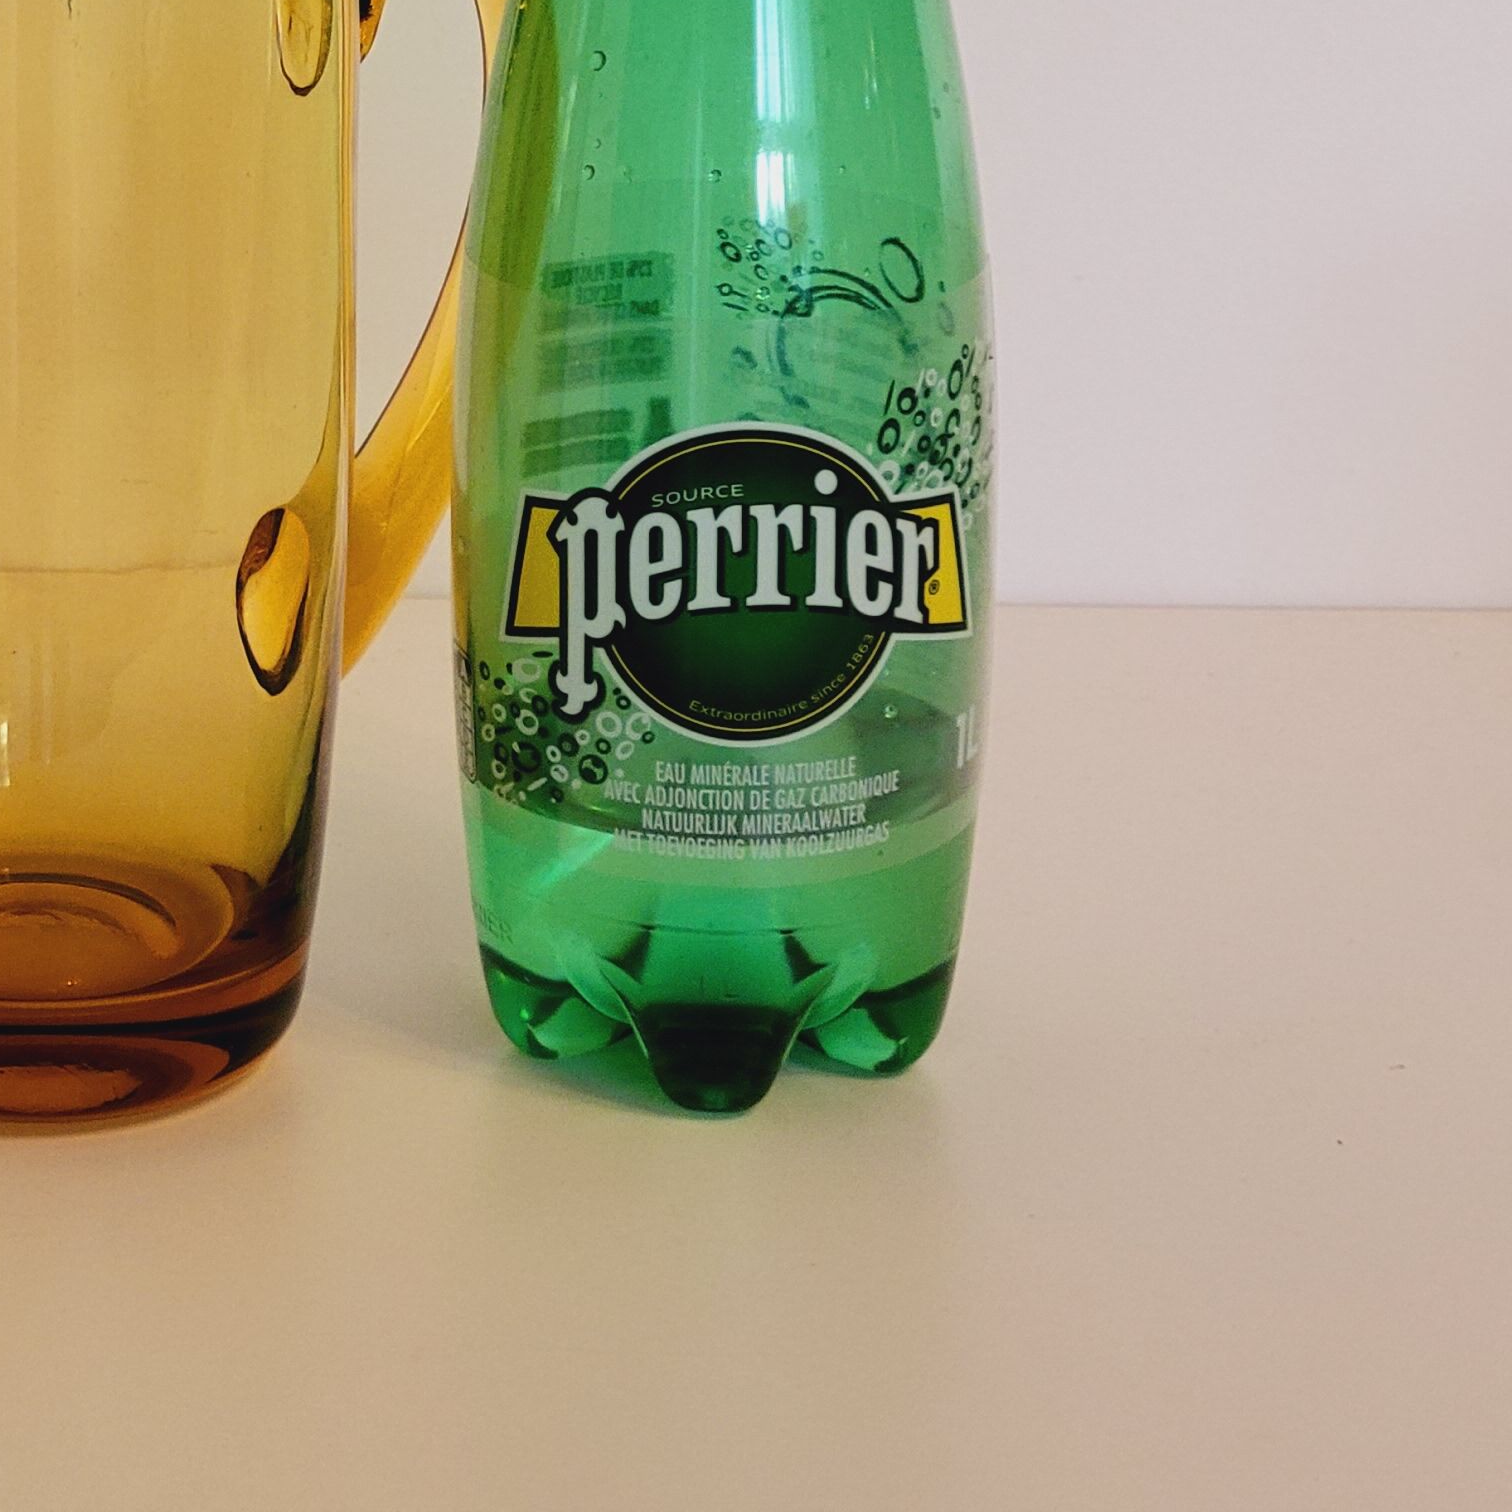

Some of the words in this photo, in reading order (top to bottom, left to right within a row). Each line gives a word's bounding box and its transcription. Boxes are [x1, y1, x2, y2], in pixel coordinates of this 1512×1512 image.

[652, 484, 744, 508] SOURCE
[555, 469, 935, 716] perrier
[688, 699, 809, 722] Extraordinaire
[810, 673, 846, 704] since
[845, 633, 875, 671] 1863
[603, 779, 641, 804] AVEC
[644, 785, 745, 811] ADJONCTION
[749, 790, 770, 810] DE
[774, 787, 806, 809] GAZ
[810, 769, 900, 807] CARBONIQUE
[655, 760, 686, 784] EAU
[690, 761, 770, 786] MINÉRALE
[774, 756, 857, 786] NATURELLE
[642, 808, 738, 835] NATUURLIJK
[741, 803, 867, 835] MINERAALWATER
[614, 827, 643, 851] MET
[646, 833, 745, 860] TOEVOEGING
[749, 838, 782, 860] VAN
[785, 820, 890, 857] KOOLZUURGAS
